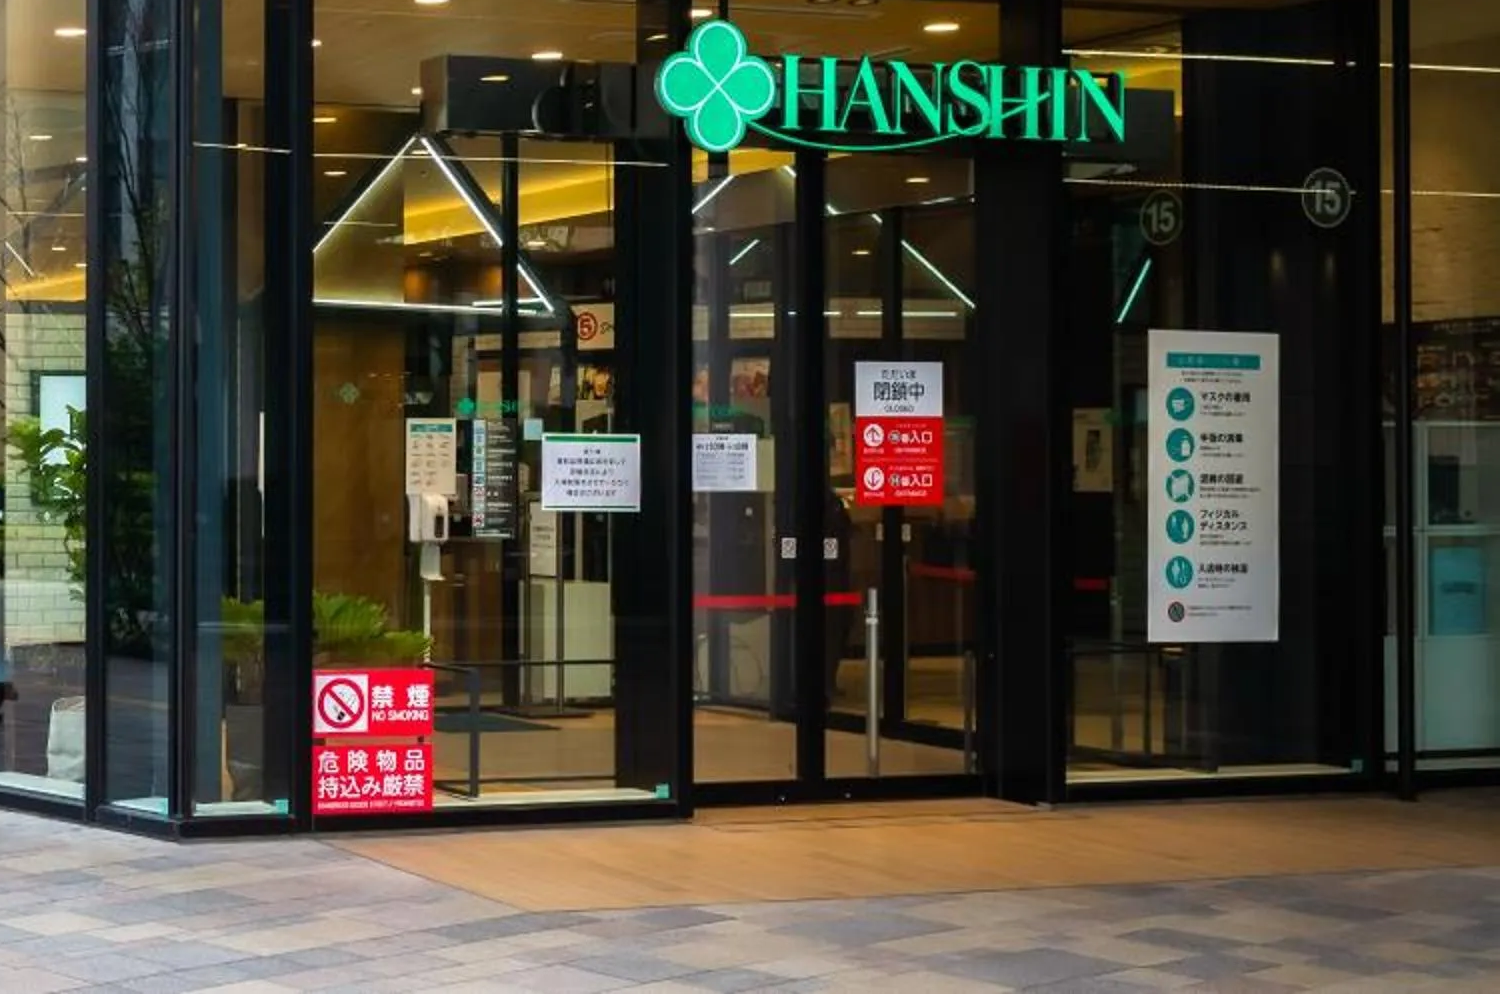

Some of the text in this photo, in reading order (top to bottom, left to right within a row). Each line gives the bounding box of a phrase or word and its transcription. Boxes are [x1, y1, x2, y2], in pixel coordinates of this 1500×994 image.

[779, 53, 1127, 144] HANSHIN
[1311, 180, 1342, 215] 15
[1148, 202, 1175, 233] 15
[873, 381, 926, 402] 閉鎖中
[1200, 391, 1252, 403] マスクの着用
[1200, 521, 1248, 531] ディスタンス
[371, 684, 430, 709] 禁煙
[371, 709, 429, 722] NO SMOKING
[317, 749, 425, 774] 危険物品
[317, 773, 425, 799] 持込み厳禁
